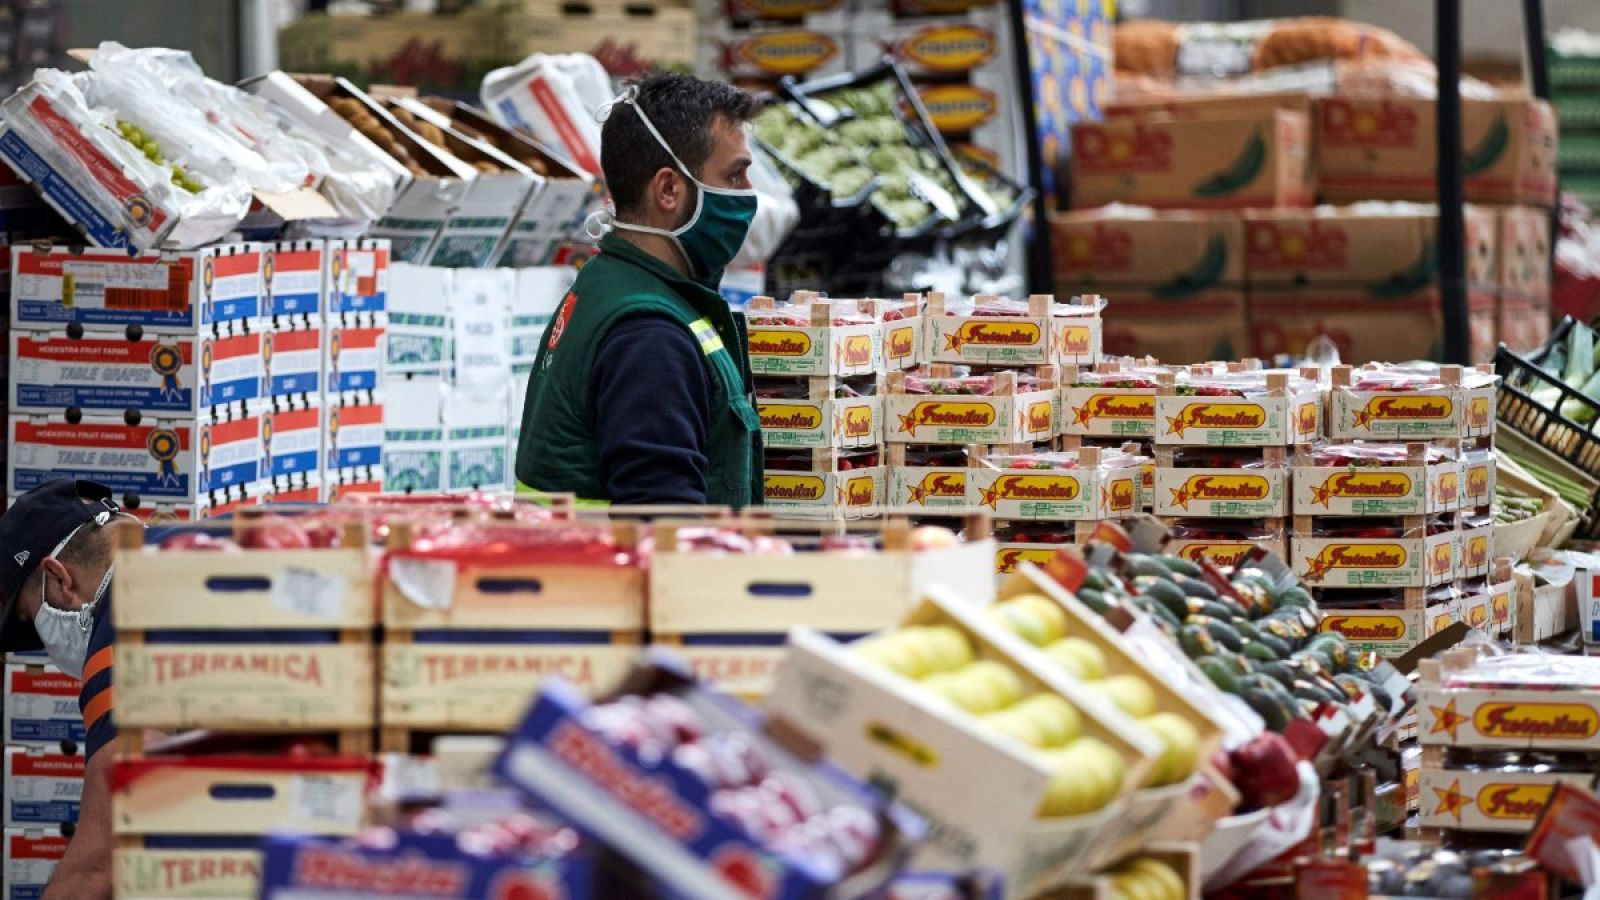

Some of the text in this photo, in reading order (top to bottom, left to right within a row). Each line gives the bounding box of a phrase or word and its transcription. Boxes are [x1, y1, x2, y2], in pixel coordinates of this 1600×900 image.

[1073, 124, 1172, 165] Dole
[1247, 219, 1348, 262] Dole
[59, 366, 153, 384] TABLE GRAPES
[57, 450, 149, 467] TABLE GRAPES
[151, 652, 325, 689] TERRAMICA
[424, 652, 596, 690] TERRAMICA
[1484, 705, 1589, 735] Fresonitas
